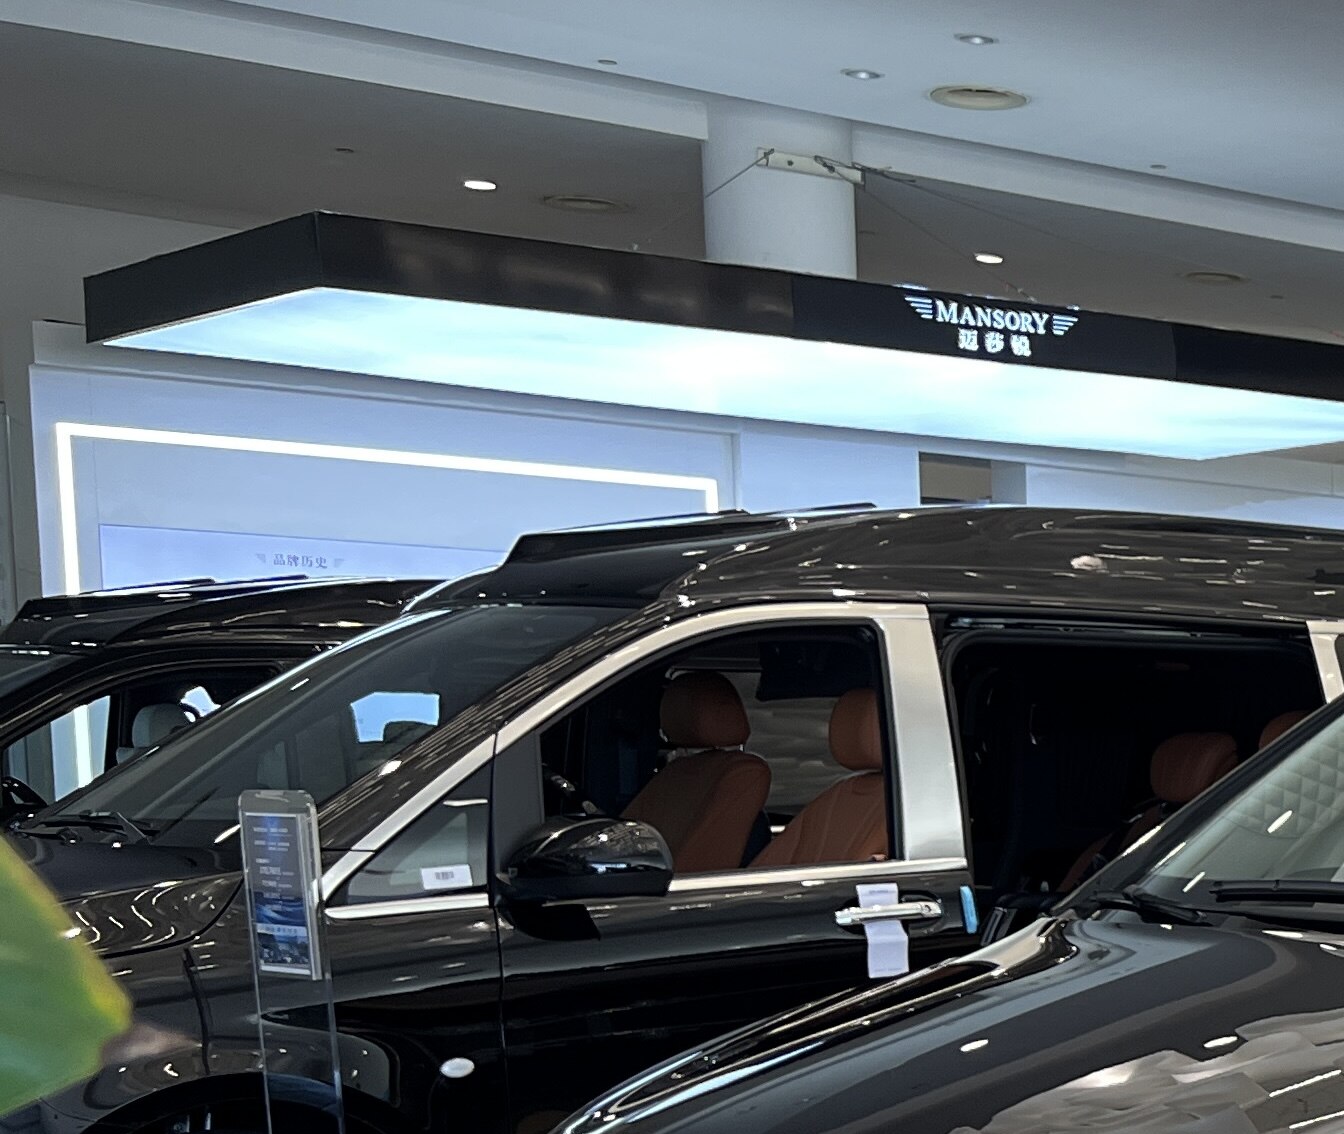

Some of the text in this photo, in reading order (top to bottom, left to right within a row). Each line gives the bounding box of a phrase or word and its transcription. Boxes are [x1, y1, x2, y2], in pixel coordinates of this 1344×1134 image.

[935, 300, 1050, 335] MANSORY
[273, 553, 328, 569] 品牌历史
